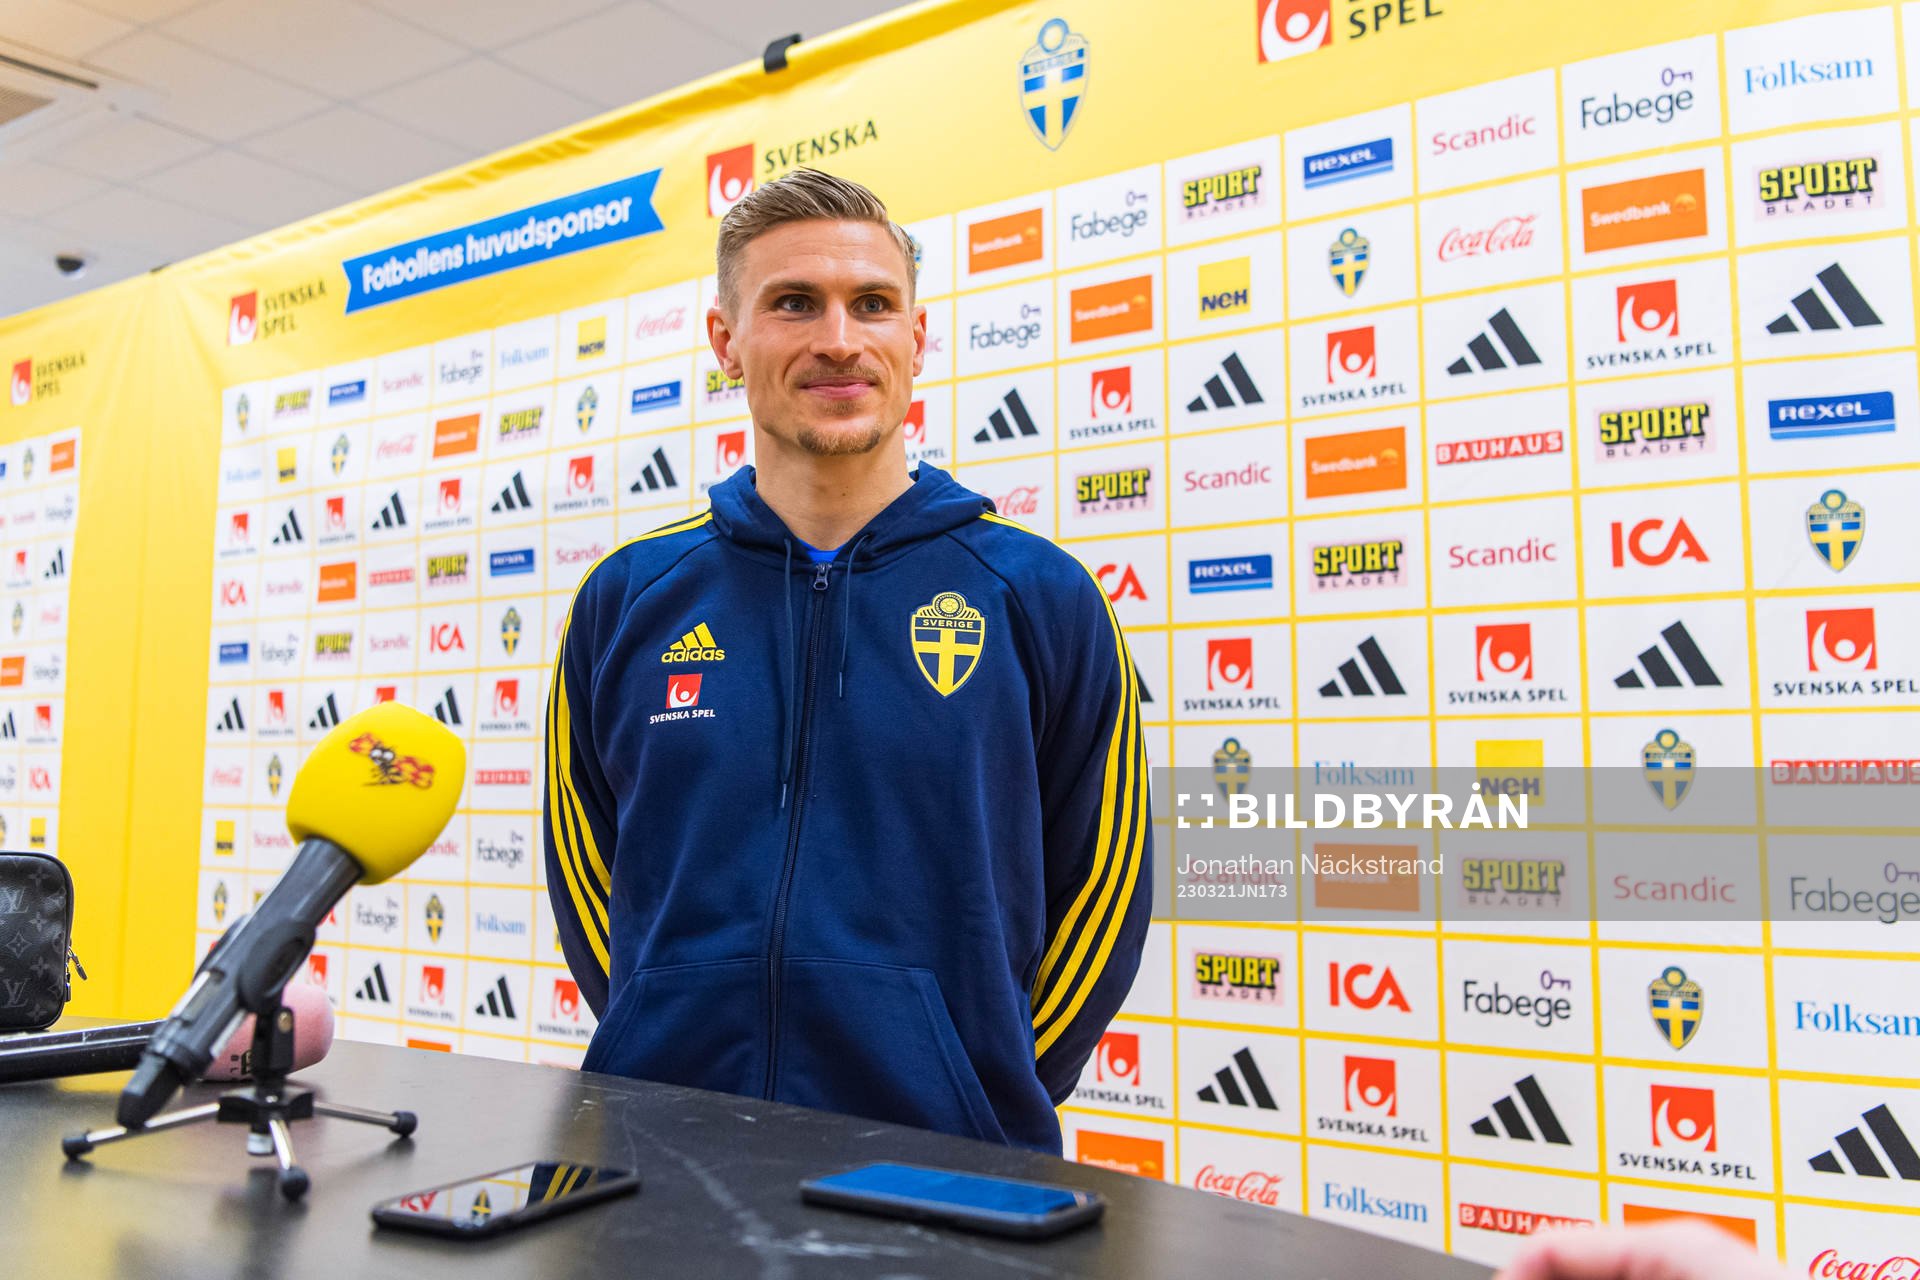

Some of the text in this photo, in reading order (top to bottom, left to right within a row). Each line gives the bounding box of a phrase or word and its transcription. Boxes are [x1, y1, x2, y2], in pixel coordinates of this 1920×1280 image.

[1744, 58, 1873, 94] Folksam
[1581, 90, 1693, 129] Fabege
[764, 120, 879, 174] SVENSKA
[1432, 114, 1535, 155] Scandic
[1184, 166, 1261, 208] SPORT
[1759, 157, 1877, 203] SPORT
[1590, 201, 1671, 227] Swedbank
[1766, 195, 1872, 216] BLADET
[1071, 209, 1147, 241] Fabege
[362, 196, 632, 294] Fotbollens huvudsponsor
[264, 279, 327, 313] SVENSKA
[263, 314, 297, 339] SPEL
[970, 322, 1040, 350] Fabege
[1586, 341, 1717, 369] SVENSKA SPEL
[1302, 383, 1407, 407] SVENSKA SPEL
[1069, 418, 1157, 440] SVENSKA SPEL
[1600, 403, 1710, 446] SPORT
[1437, 431, 1563, 465] BAUHAUS
[1606, 440, 1705, 458] BLADET
[1076, 468, 1150, 503] SPORT
[1184, 462, 1271, 492] Scandic
[1081, 499, 1148, 514] BLADET
[1449, 538, 1557, 568] Scandic
[1611, 517, 1710, 567] ICA
[1313, 540, 1402, 577] SPORT
[221, 579, 246, 605] ICA
[1095, 562, 1148, 603] CA
[1318, 574, 1400, 589] BLADET
[430, 623, 464, 653] ICA
[923, 619, 974, 628] SVERIGE
[661, 647, 726, 663] adidas
[1449, 688, 1567, 705] SVENSKA SPEL
[1773, 679, 1919, 697] SVENSKA SPEL
[650, 708, 715, 724] SVENSKA SPEL
[1184, 697, 1280, 711] SVENSKA SPEL
[1313, 760, 1415, 787] Folksam
[1772, 760, 1920, 784] BAUHAUS
[477, 838, 523, 868] Fabege
[1462, 857, 1565, 896] SPORT
[1613, 875, 1736, 904] Scandic
[1790, 876, 1920, 924] Fabege
[356, 904, 399, 934] Fabege
[476, 914, 526, 937] Folksam
[1196, 953, 1280, 990] SPORT
[1200, 986, 1277, 1001] BLADET
[1329, 961, 1413, 1014] ICA
[1463, 979, 1571, 1028] Fabege
[1075, 1087, 1166, 1110] SVENSKA SPEL
[1318, 1117, 1429, 1143] SVENSKA SPEL
[1619, 1152, 1757, 1181] SVENSKA SPEL
[1323, 1182, 1428, 1223] Folksam
